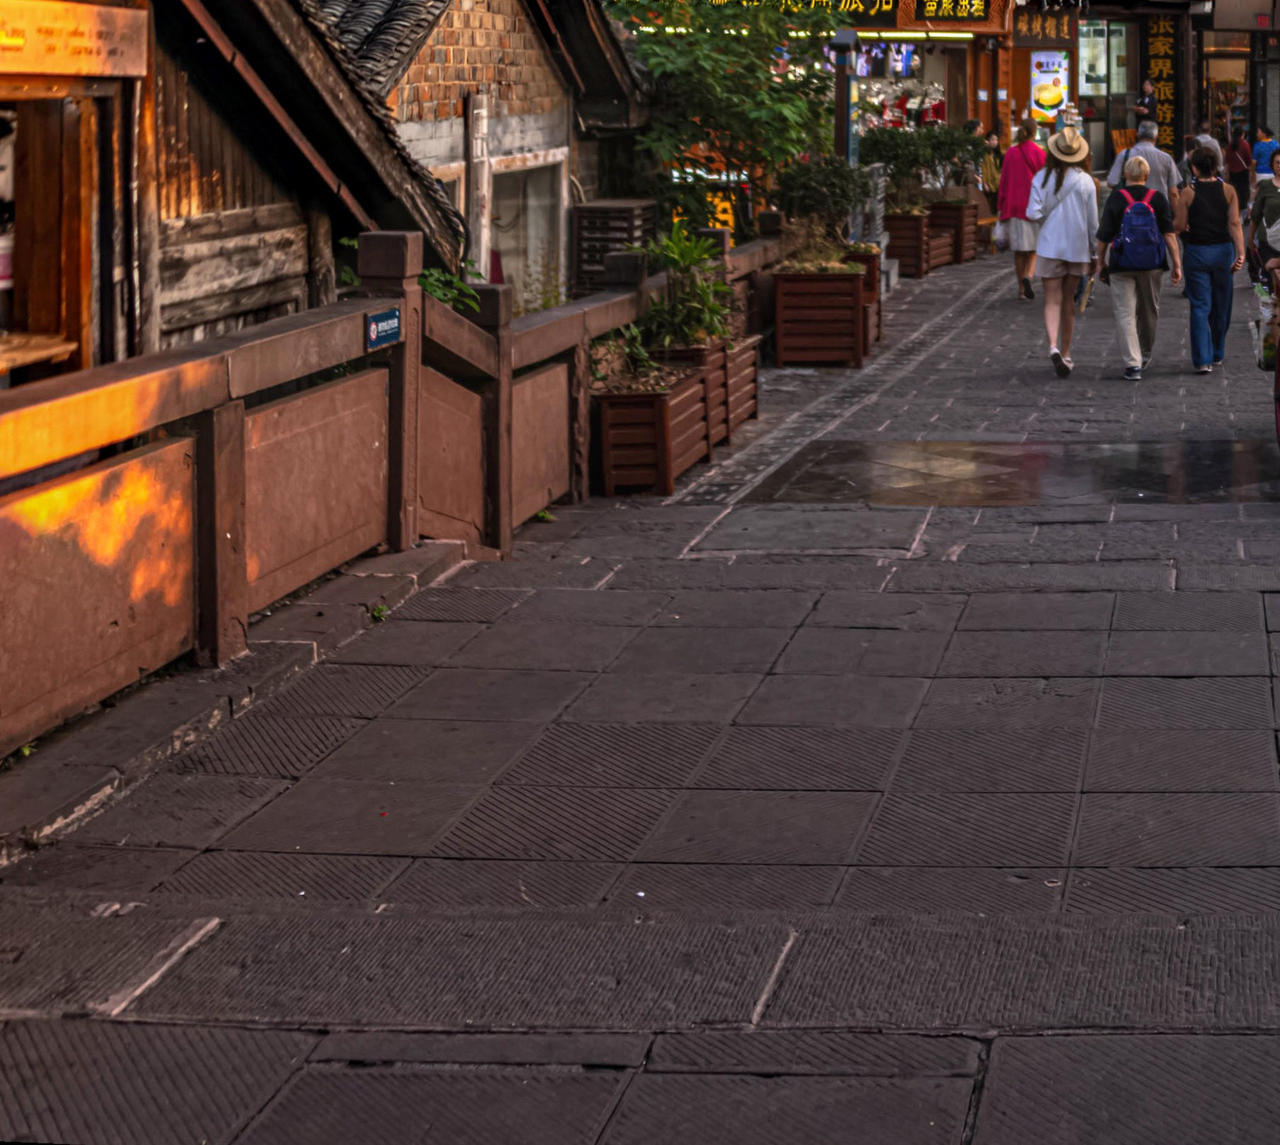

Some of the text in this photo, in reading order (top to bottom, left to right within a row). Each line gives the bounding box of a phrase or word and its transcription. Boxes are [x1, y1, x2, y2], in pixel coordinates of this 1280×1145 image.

[1147, 14, 1175, 155] 张家界旅游接
